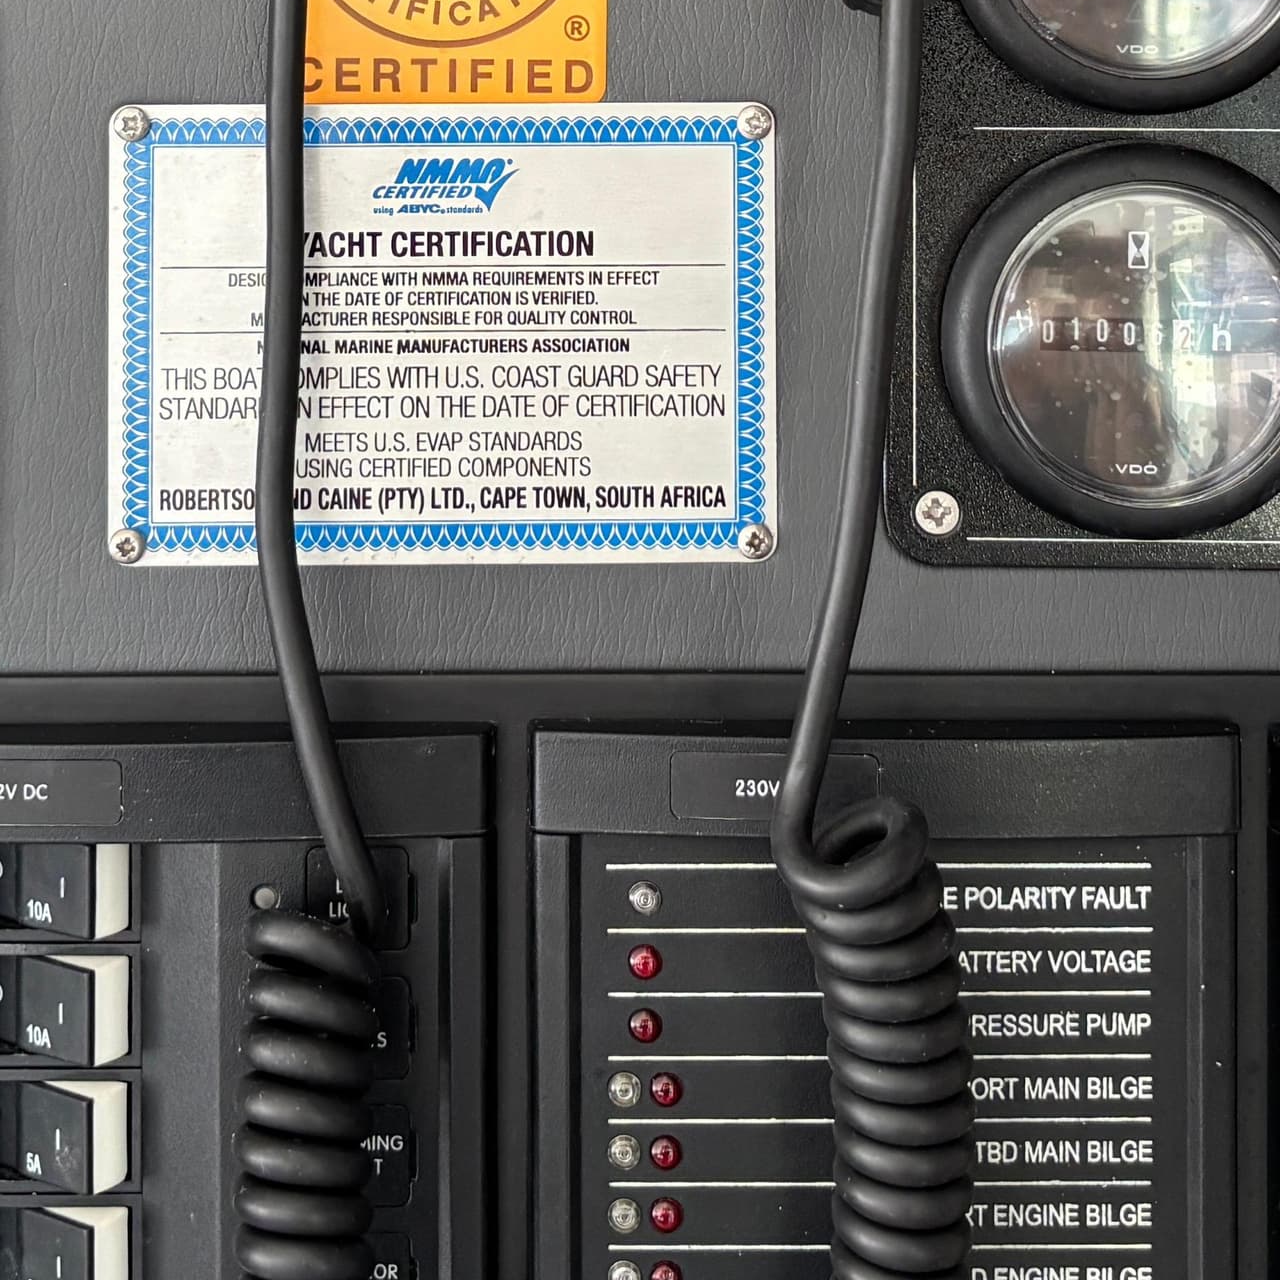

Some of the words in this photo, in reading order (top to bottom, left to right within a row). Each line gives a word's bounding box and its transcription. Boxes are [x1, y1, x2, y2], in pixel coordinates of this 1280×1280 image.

[1116, 44, 1159, 55] VDO
[394, 158, 506, 184] NMMA
[372, 185, 473, 199] CERTIFIED
[373, 206, 394, 216] using
[397, 204, 441, 214] ABYC
[447, 206, 483, 214] standards
[391, 231, 593, 257] CERTIFICATION
[382, 272, 417, 286] WITH
[423, 272, 468, 286] NMMA
[473, 271, 584, 286] REQUIREMENTS
[589, 271, 602, 285] IN
[608, 271, 659, 285] EFFECT
[335, 340, 392, 353] MARINE
[397, 339, 527, 354] MANUFACTURERS
[532, 338, 629, 352] ASSOCIATION
[161, 368, 207, 391] THIS
[387, 366, 438, 388] WITH
[446, 366, 483, 388] U.S.
[492, 366, 561, 388] COAST
[568, 365, 638, 387] GUARD
[646, 365, 721, 387] SAFETY
[305, 433, 368, 452] MEETS
[375, 432, 409, 452] U.S.
[417, 432, 462, 451] EVAP
[469, 431, 582, 451] STANDARDS
[296, 458, 353, 479] USING
[360, 458, 451, 477] CERTIFIED
[459, 457, 591, 477] COMPONENTS
[1116, 462, 1157, 474] VDO
[319, 488, 371, 510] CAINE
[379, 488, 424, 514] (PTY)
[431, 487, 474, 513] LTD.,
[480, 487, 526, 509] CAPE
[533, 486, 590, 512] TOWN,
[596, 486, 654, 508] SOUTH
[661, 486, 726, 507] AFRICA
[24, 784, 47, 800] DC
[735, 780, 780, 797] 230V
[965, 887, 1076, 910] POLARITY
[1082, 886, 1151, 909] FAULT
[27, 900, 52, 923] 10A
[1048, 950, 1151, 973] VOLTAGE
[1087, 1013, 1151, 1036] PUMP
[27, 1024, 51, 1048] 10A
[1025, 1077, 1079, 1099] MAIN
[1088, 1077, 1153, 1099] BILGE
[1025, 1141, 1079, 1163] MAIN
[1088, 1140, 1153, 1162] BILGE
[27, 1153, 41, 1174] 5A
[994, 1203, 1079, 1226] ENGINE
[1087, 1203, 1152, 1226] BILGE
